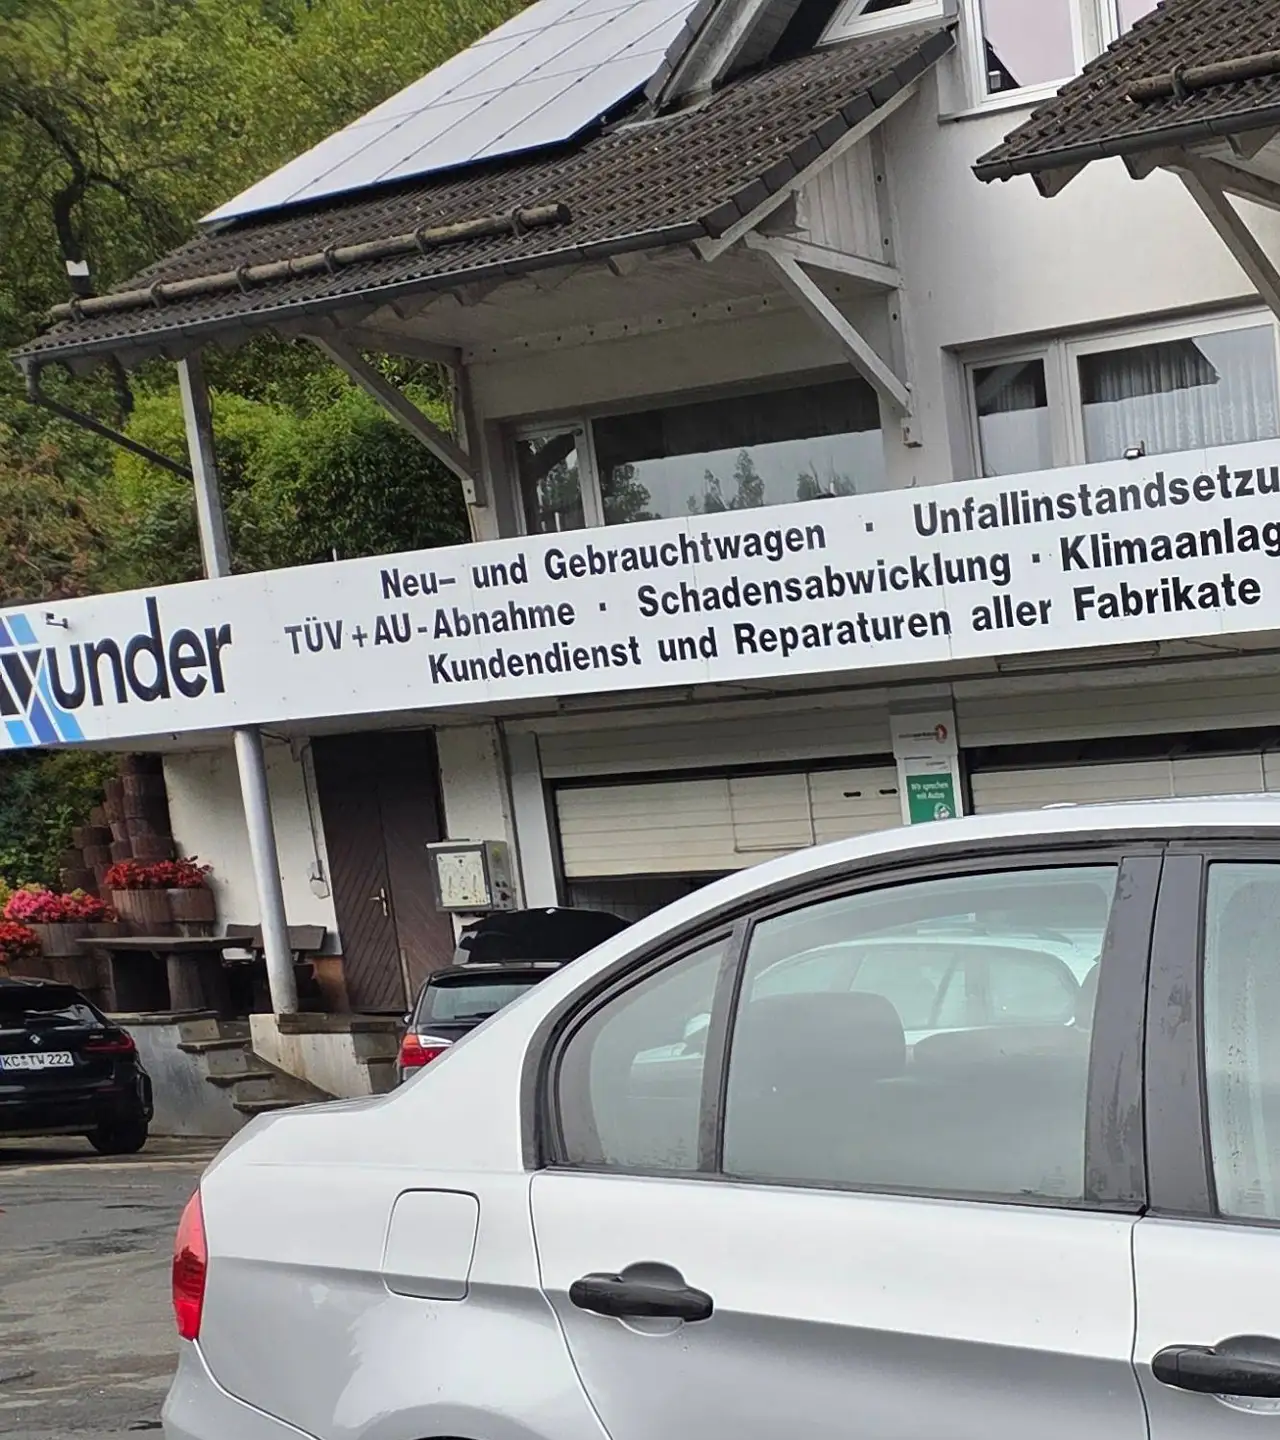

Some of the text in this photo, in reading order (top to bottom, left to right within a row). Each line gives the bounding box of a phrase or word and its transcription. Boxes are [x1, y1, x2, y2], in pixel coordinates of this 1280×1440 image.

[472, 553, 529, 589] und
[545, 526, 826, 581] Gebrauchtwagen
[637, 552, 1011, 617] Schadensabwicklung
[428, 573, 1261, 684] Kundendienst und Reparaturen aller Fabrikate
[49, 1053, 71, 1065] 222
